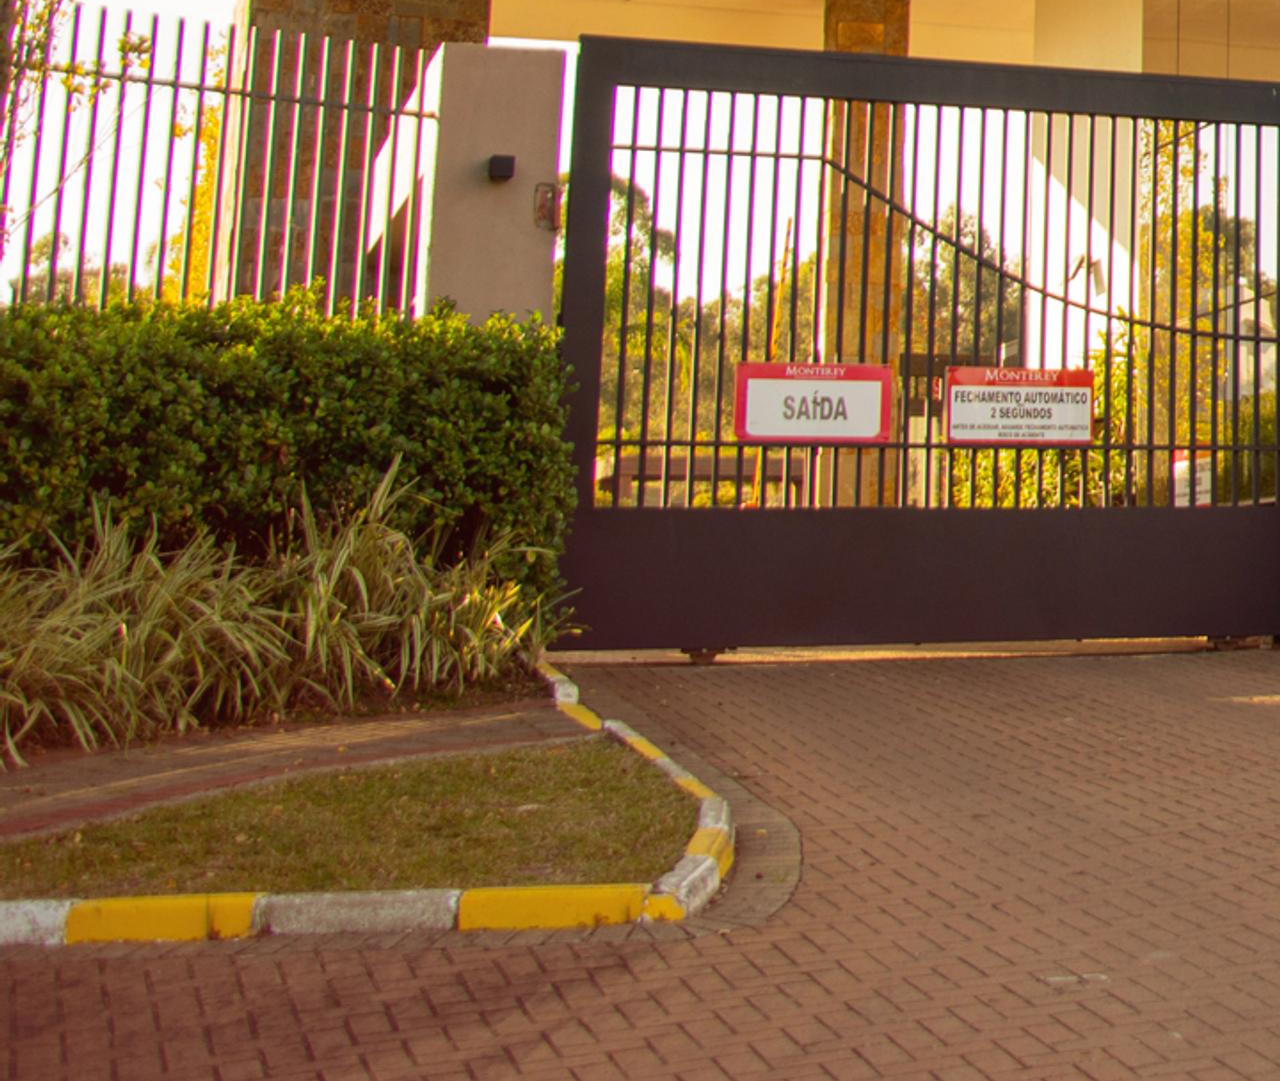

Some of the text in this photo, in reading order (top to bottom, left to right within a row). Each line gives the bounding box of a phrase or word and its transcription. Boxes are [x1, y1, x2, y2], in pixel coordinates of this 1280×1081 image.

[785, 365, 847, 376] MONTEREY
[984, 369, 1060, 382] MONTEREY
[954, 389, 1088, 404] FECHAMENTO AUTOMÁTICO
[782, 389, 848, 421] SAÍDA
[990, 408, 1053, 419] 2 SEGUNDOS
